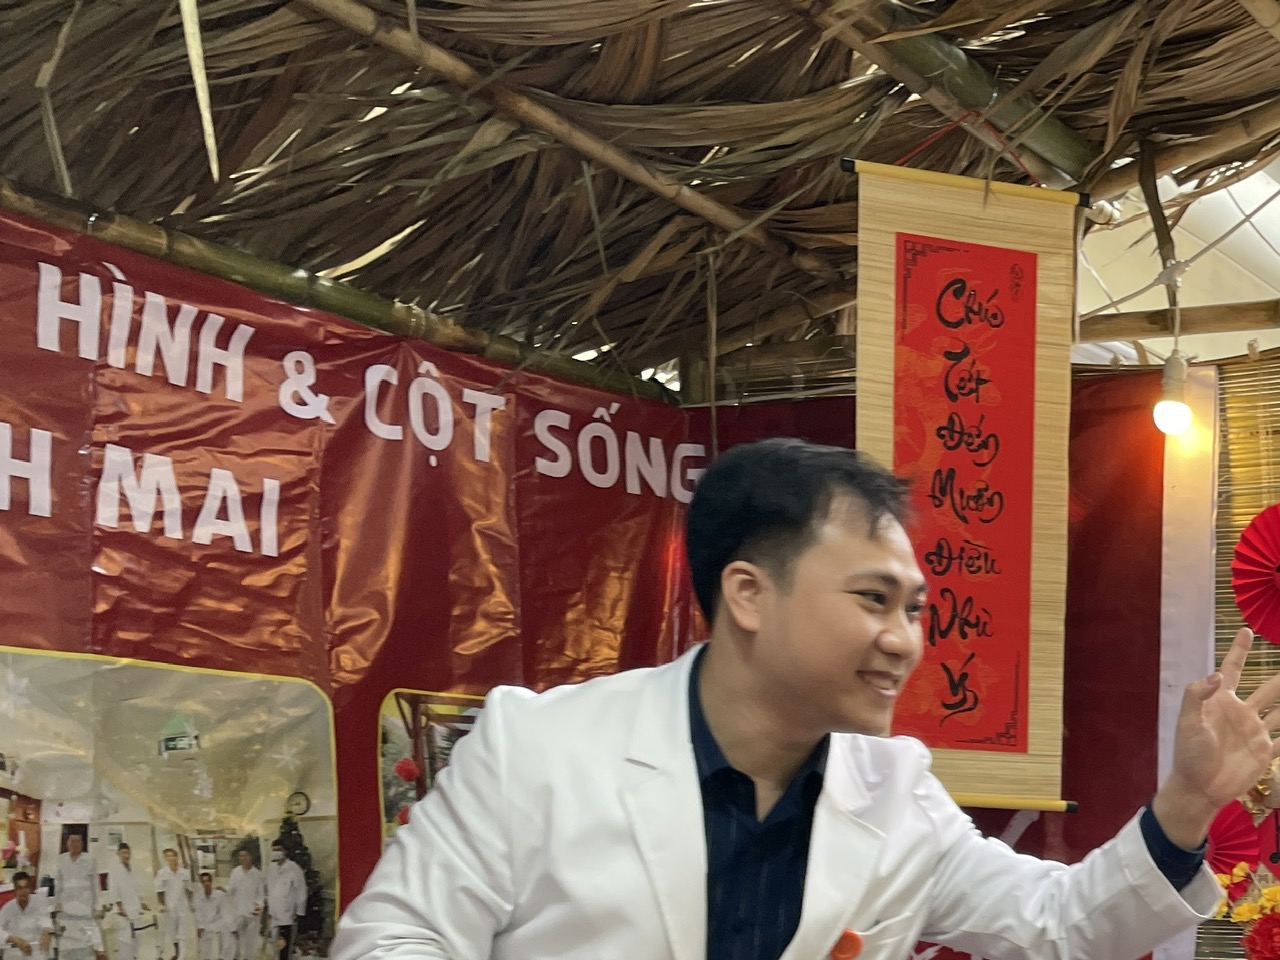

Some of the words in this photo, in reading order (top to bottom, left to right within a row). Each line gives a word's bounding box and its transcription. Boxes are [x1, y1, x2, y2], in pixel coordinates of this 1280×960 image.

[37, 262, 256, 402] HÌNH
[278, 351, 336, 425] &
[364, 361, 506, 467] CỘT
[534, 402, 706, 504] SỐNG
[943, 337, 992, 403] Tết
[936, 412, 1000, 468] Đến
[95, 443, 280, 557] MAI
